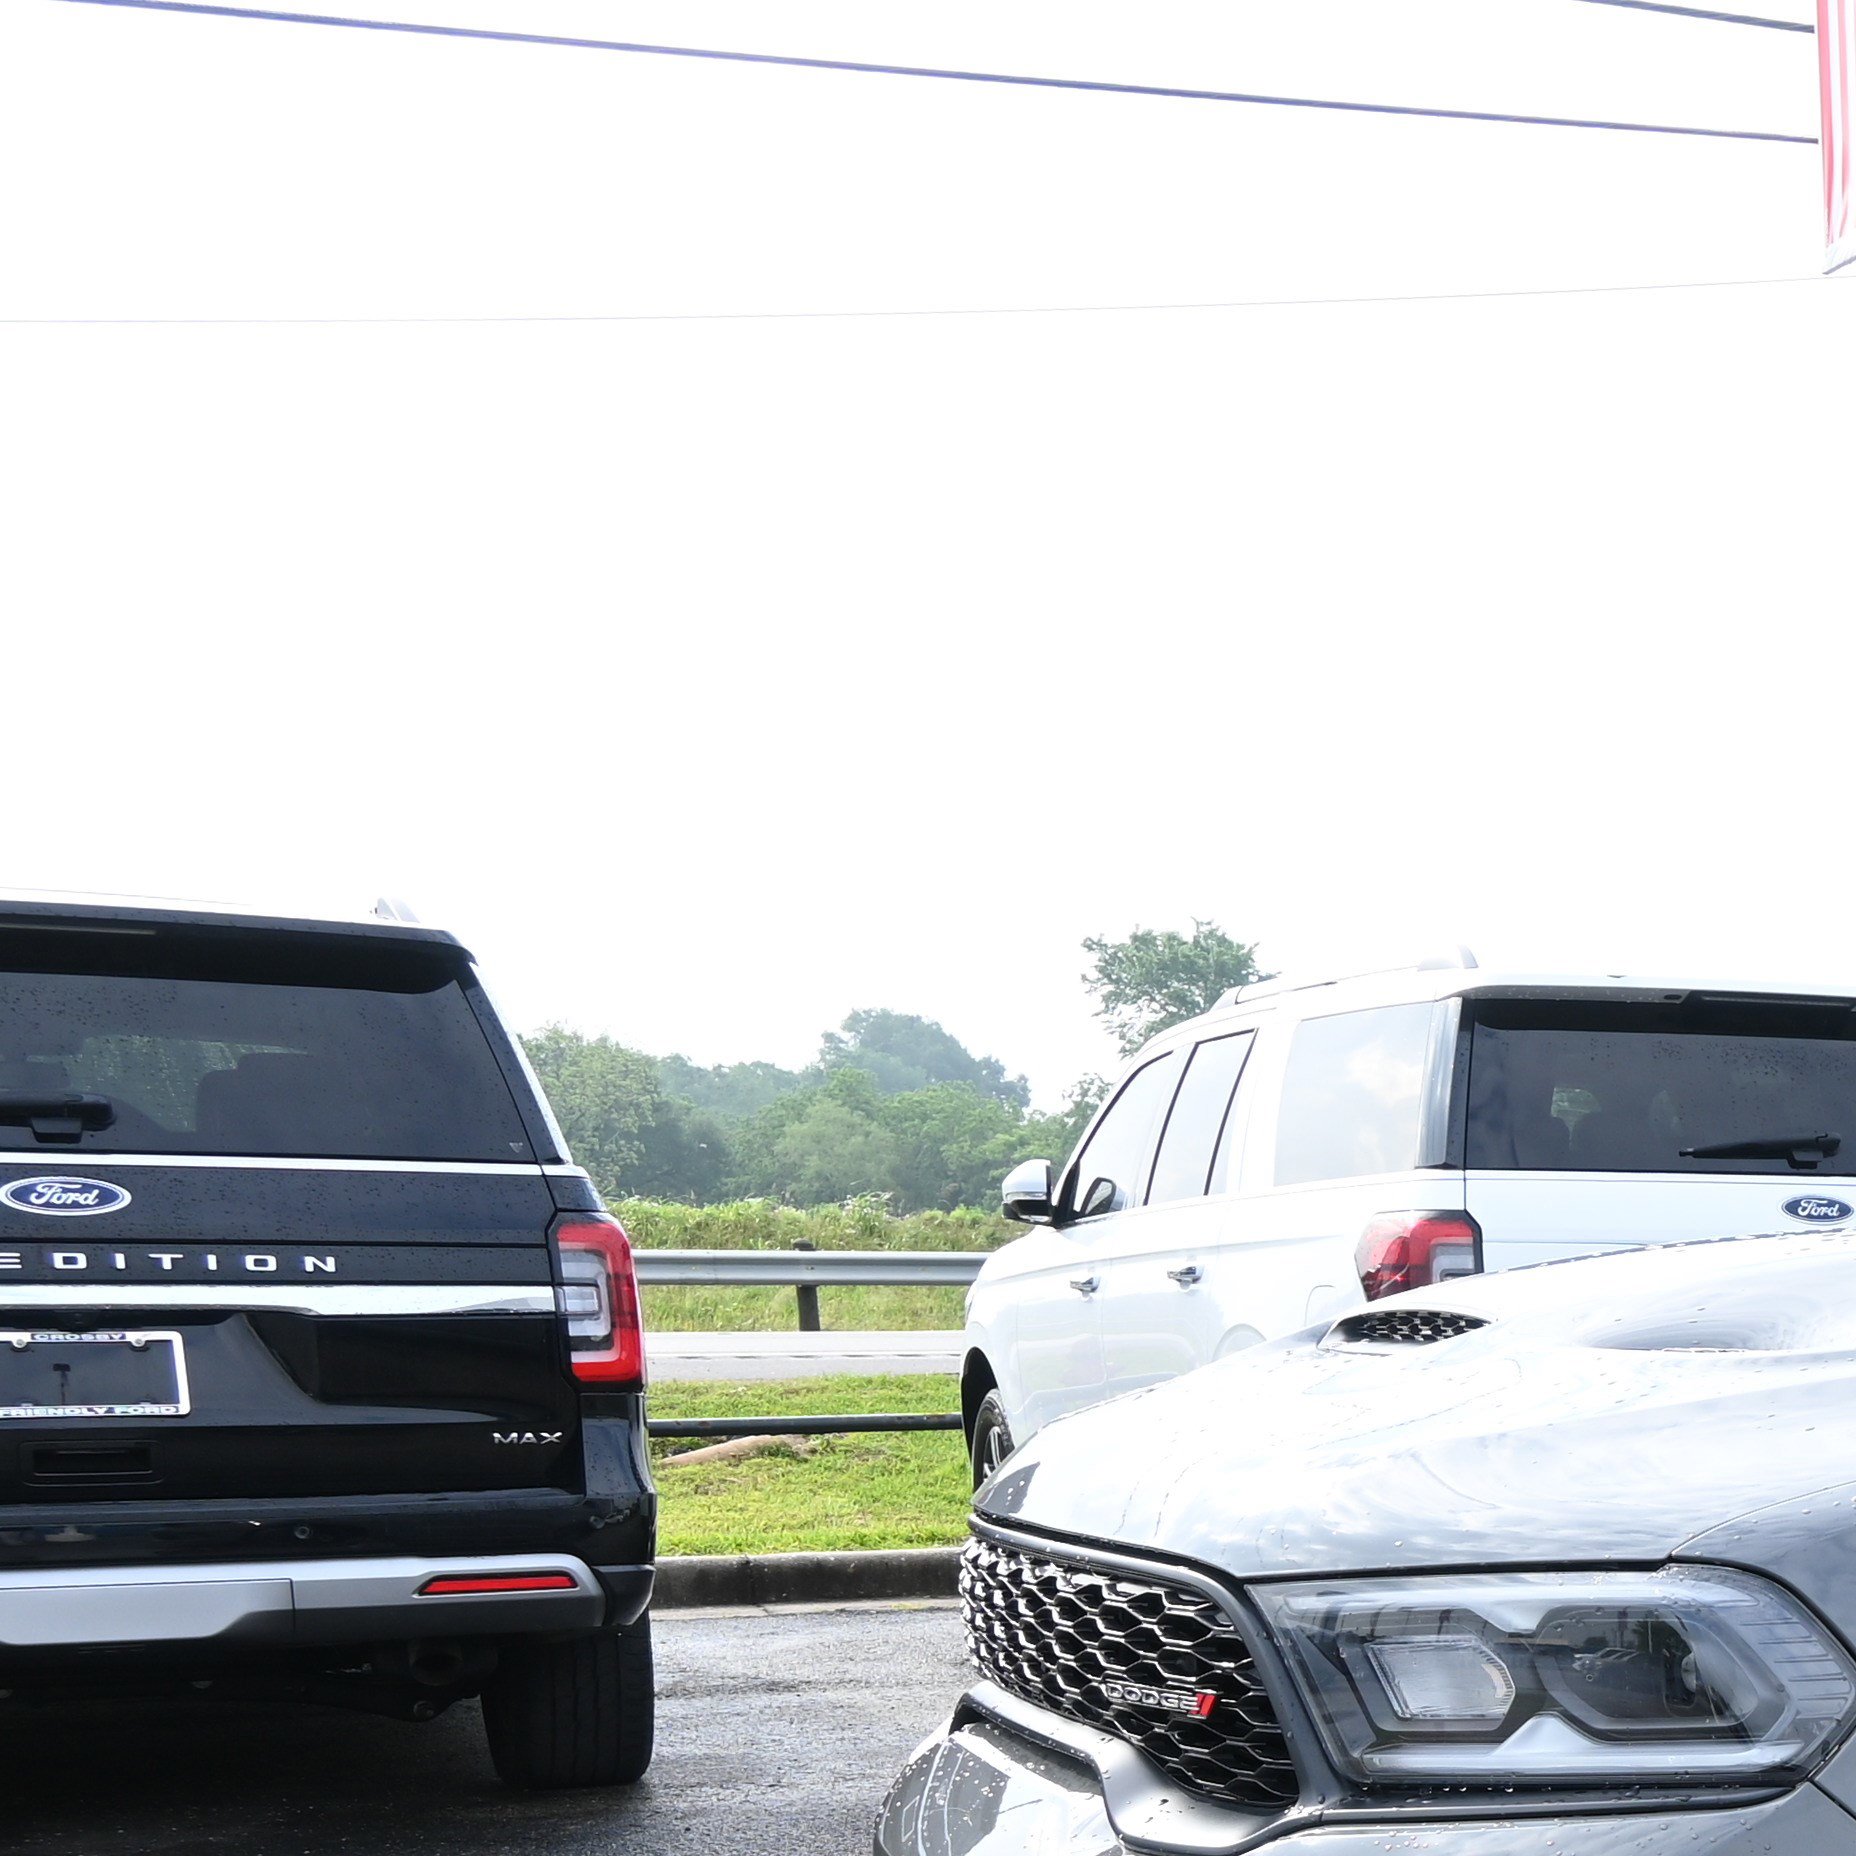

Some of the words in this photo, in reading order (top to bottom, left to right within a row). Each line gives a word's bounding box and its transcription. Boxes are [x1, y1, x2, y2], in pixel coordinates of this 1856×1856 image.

[29, 1182, 101, 1206] Ford
[1797, 1199, 1841, 1217] Ford
[33, 1333, 123, 1341] CROSBY
[115, 1405, 178, 1415] FORD
[492, 1431, 563, 1445] MAX
[1105, 1682, 1200, 1711] DODGE
